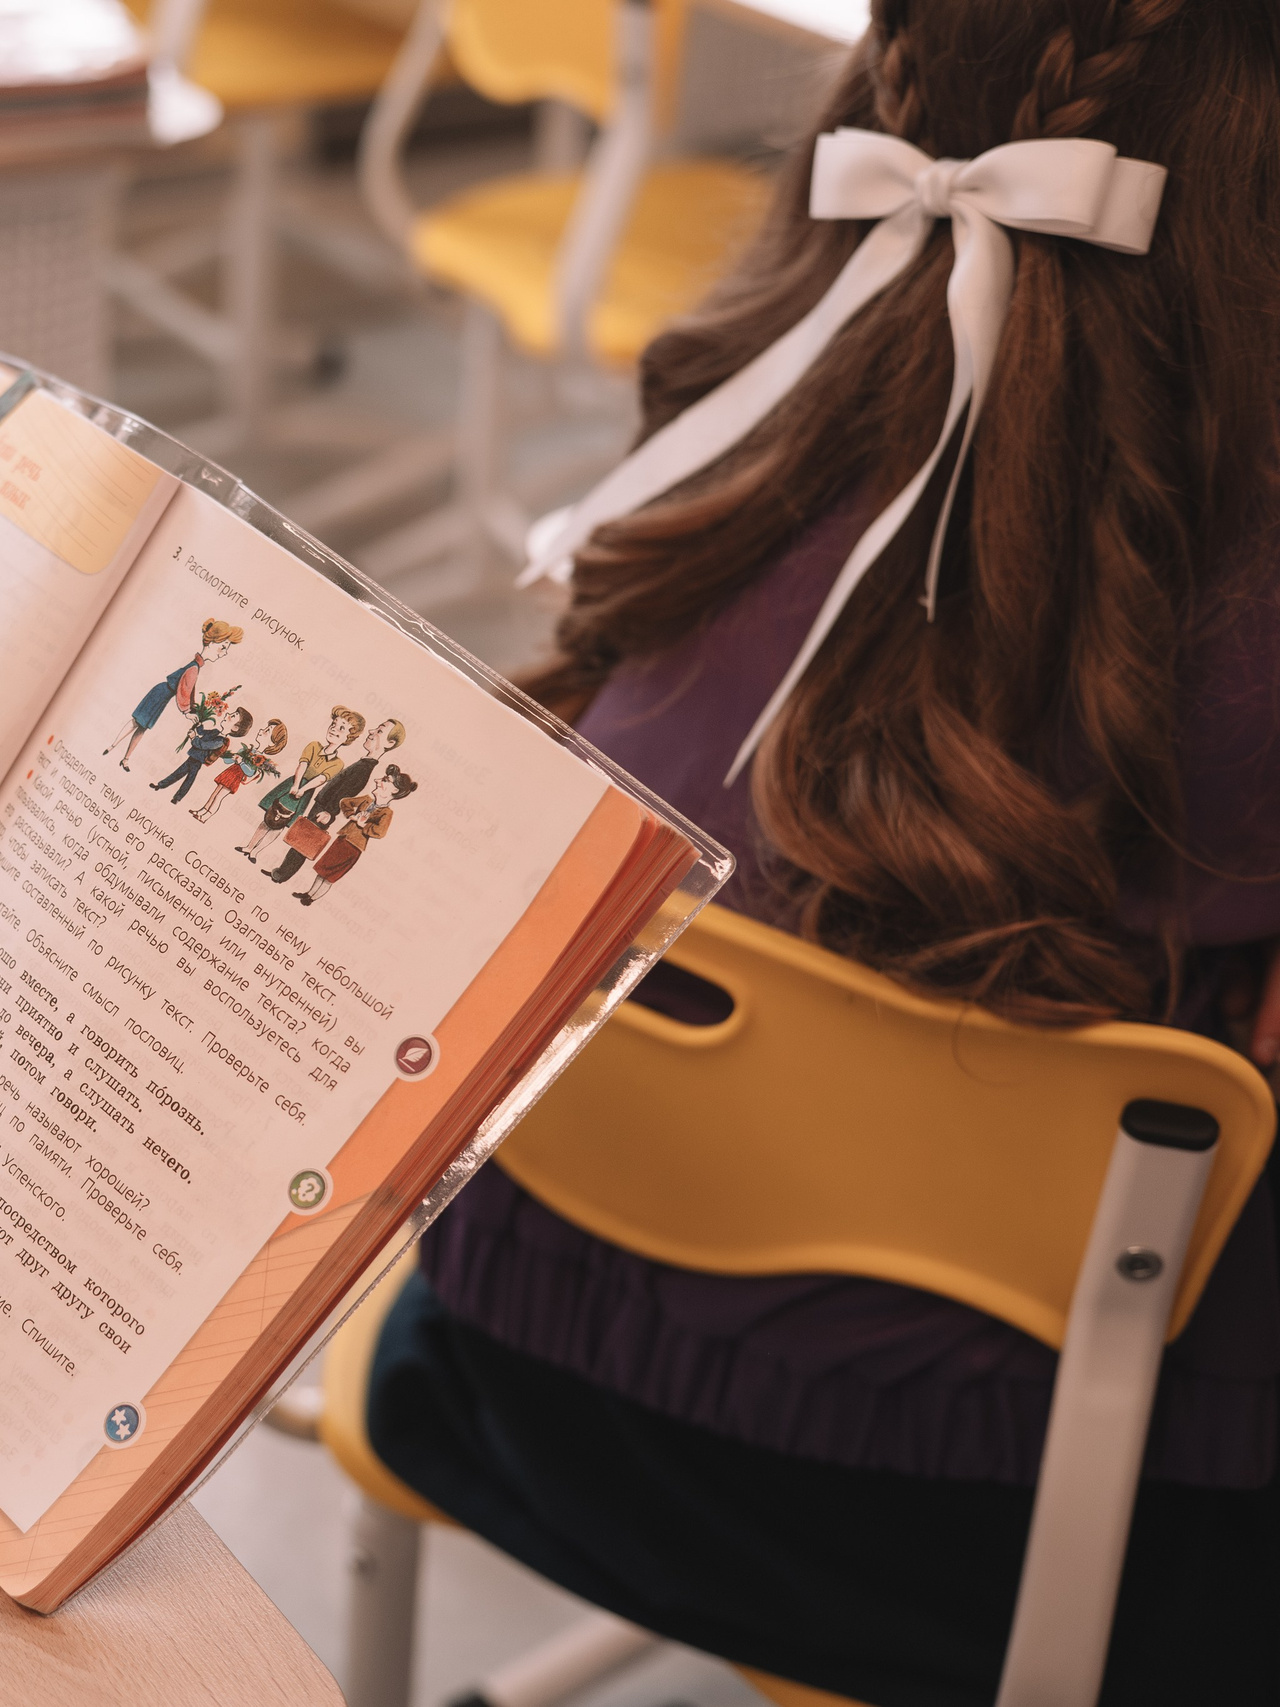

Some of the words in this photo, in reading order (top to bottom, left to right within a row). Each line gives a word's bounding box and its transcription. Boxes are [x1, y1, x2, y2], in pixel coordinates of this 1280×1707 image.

[171, 545, 183, 562] 3.
[184, 554, 249, 609] Рассмотрите
[250, 607, 306, 652] рисунок.
[8, 836, 30, 862] чтобы
[29, 859, 68, 899] записать
[72, 896, 108, 929] текст?
[32, 775, 55, 801] Какой
[52, 799, 83, 828] речью
[86, 824, 130, 871] (устной,
[136, 869, 215, 935] письменной
[218, 935, 248, 962] или
[252, 962, 338, 1033] внутренней)
[343, 1034, 366, 1057] вы
[53, 739, 97, 786] Определите
[99, 782, 126, 810] тему
[125, 807, 175, 852] рисунка.
[184, 850, 246, 905] Составьте
[250, 904, 270, 924] по
[275, 924, 312, 957] нему
[315, 956, 395, 1021] небольшой
[58, 775, 120, 833] подготовьтесь
[124, 832, 146, 852] его
[146, 851, 214, 911] рассказать.
[224, 909, 295, 972] Озаглавьте
[300, 970, 337, 1007] текст.
[13, 815, 73, 872] рассказывали?
[73, 870, 86, 886] А
[89, 885, 127, 918] какой
[126, 918, 169, 955] речью
[175, 956, 197, 977] вы
[202, 978, 302, 1064] воспользуетесь
[307, 1066, 339, 1092] для
[21, 879, 87, 941] составленный
[86, 938, 104, 956] по
[103, 954, 157, 1001] рисунку
[160, 998, 195, 1034] текст.
[200, 1030, 270, 1094] Проверьте
[274, 1094, 307, 1127] себя.
[25, 928, 79, 982] Объясните
[82, 981, 121, 1018] смысл
[123, 1017, 185, 1075] пословиц.
[61, 833, 90, 862] когда
[94, 861, 166, 925] обдумывали
[171, 925, 250, 992] содержание
[256, 992, 307, 1035] текста?
[310, 1037, 352, 1074] когда
[14, 994, 64, 1042] приятно
[67, 1041, 80, 1057] и
[84, 1057, 143, 1114] слушать.
[18, 969, 59, 1013] вместе,
[65, 1012, 76, 1025] а
[79, 1023, 139, 1079] говорить
[9, 1048, 47, 1086] потом
[49, 1085, 98, 1134] говори.
[14, 1023, 56, 1069] вечера,
[63, 1068, 74, 1082] а
[79, 1082, 135, 1135] слушать
[141, 1135, 192, 1185] нечего.
[1, 1152, 66, 1222] Успенского.
[8, 1114, 26, 1133] по
[28, 1133, 73, 1179] памяти.
[79, 1176, 147, 1242] Проверьте
[152, 1242, 183, 1276] себя.
[24, 1100, 83, 1154] называют
[84, 1154, 151, 1212] хорошей?
[13, 1247, 50, 1279] друг
[50, 1280, 96, 1321] другу
[98, 1321, 133, 1355] свои
[21, 1318, 78, 1378] Спишите.
[82, 1276, 146, 1336] которого
